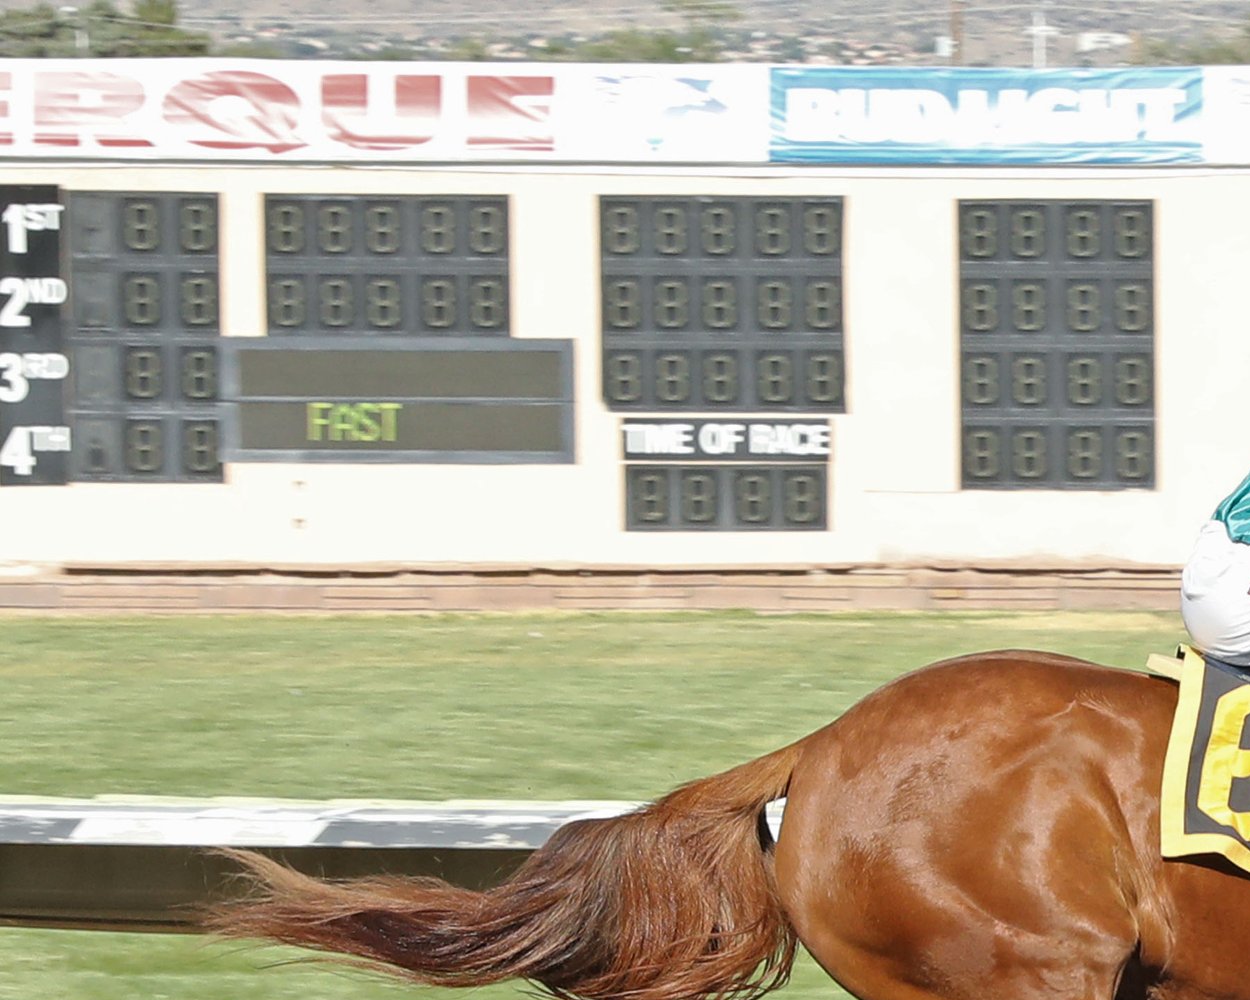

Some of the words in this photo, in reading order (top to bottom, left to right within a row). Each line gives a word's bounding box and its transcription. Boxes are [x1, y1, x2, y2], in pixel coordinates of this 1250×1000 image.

[0, 70, 555, 153] RQUE
[2, 203, 65, 254] 1ST
[0, 277, 68, 327] 2ND
[306, 402, 402, 441] FAST
[621, 423, 695, 454] TIME
[698, 423, 746, 454] OF
[749, 424, 832, 454] RACE
